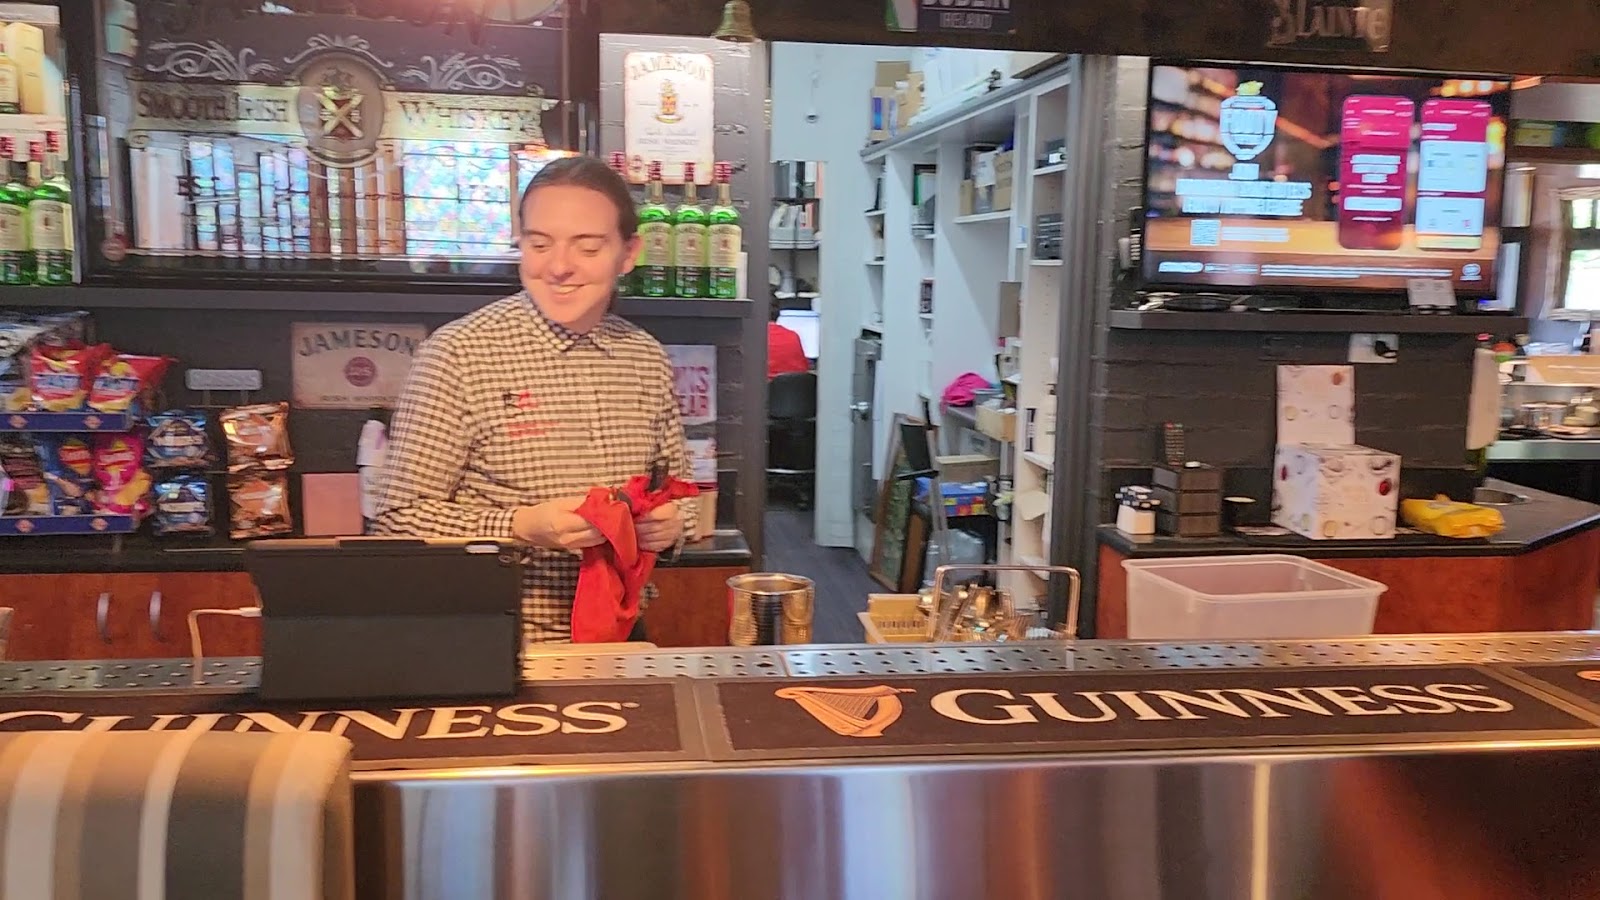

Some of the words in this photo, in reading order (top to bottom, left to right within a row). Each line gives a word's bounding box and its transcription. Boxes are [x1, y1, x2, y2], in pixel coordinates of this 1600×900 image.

[631, 55, 707, 81] JAMESON
[299, 328, 420, 357] JAMESON
[930, 683, 1515, 725] GUINNESS
